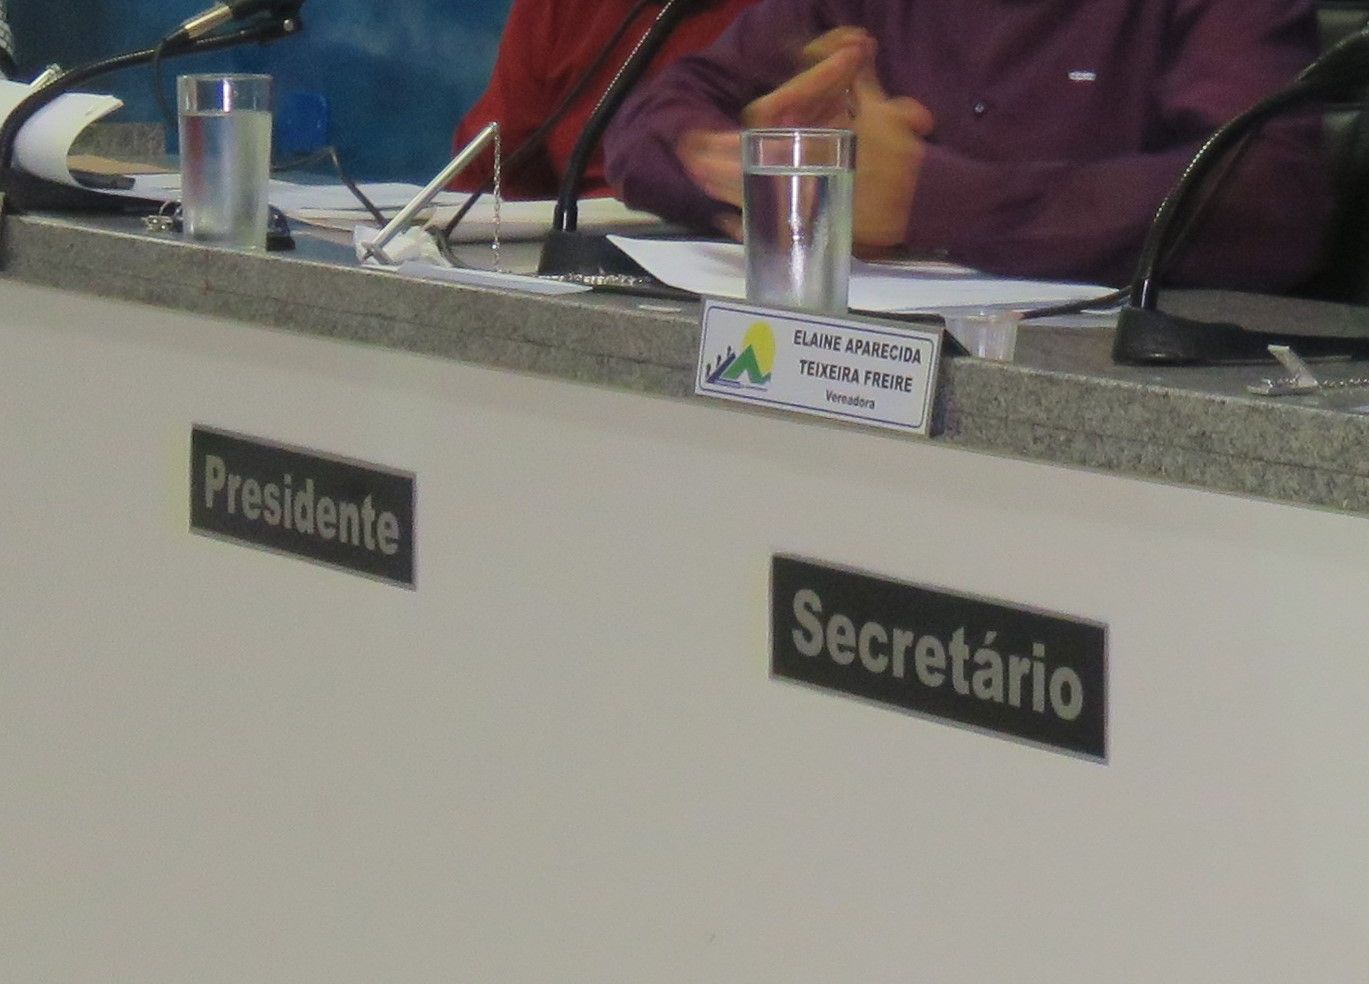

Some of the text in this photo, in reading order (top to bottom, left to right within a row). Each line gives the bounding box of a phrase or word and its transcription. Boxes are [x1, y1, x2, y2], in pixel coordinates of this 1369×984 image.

[793, 329, 921, 364] ELAINE APARECIDA
[799, 359, 913, 393] TEIXEIRA FREIRE
[825, 389, 876, 410] Vereadora
[204, 454, 400, 556] Presidente
[791, 588, 1084, 721] Secretário
